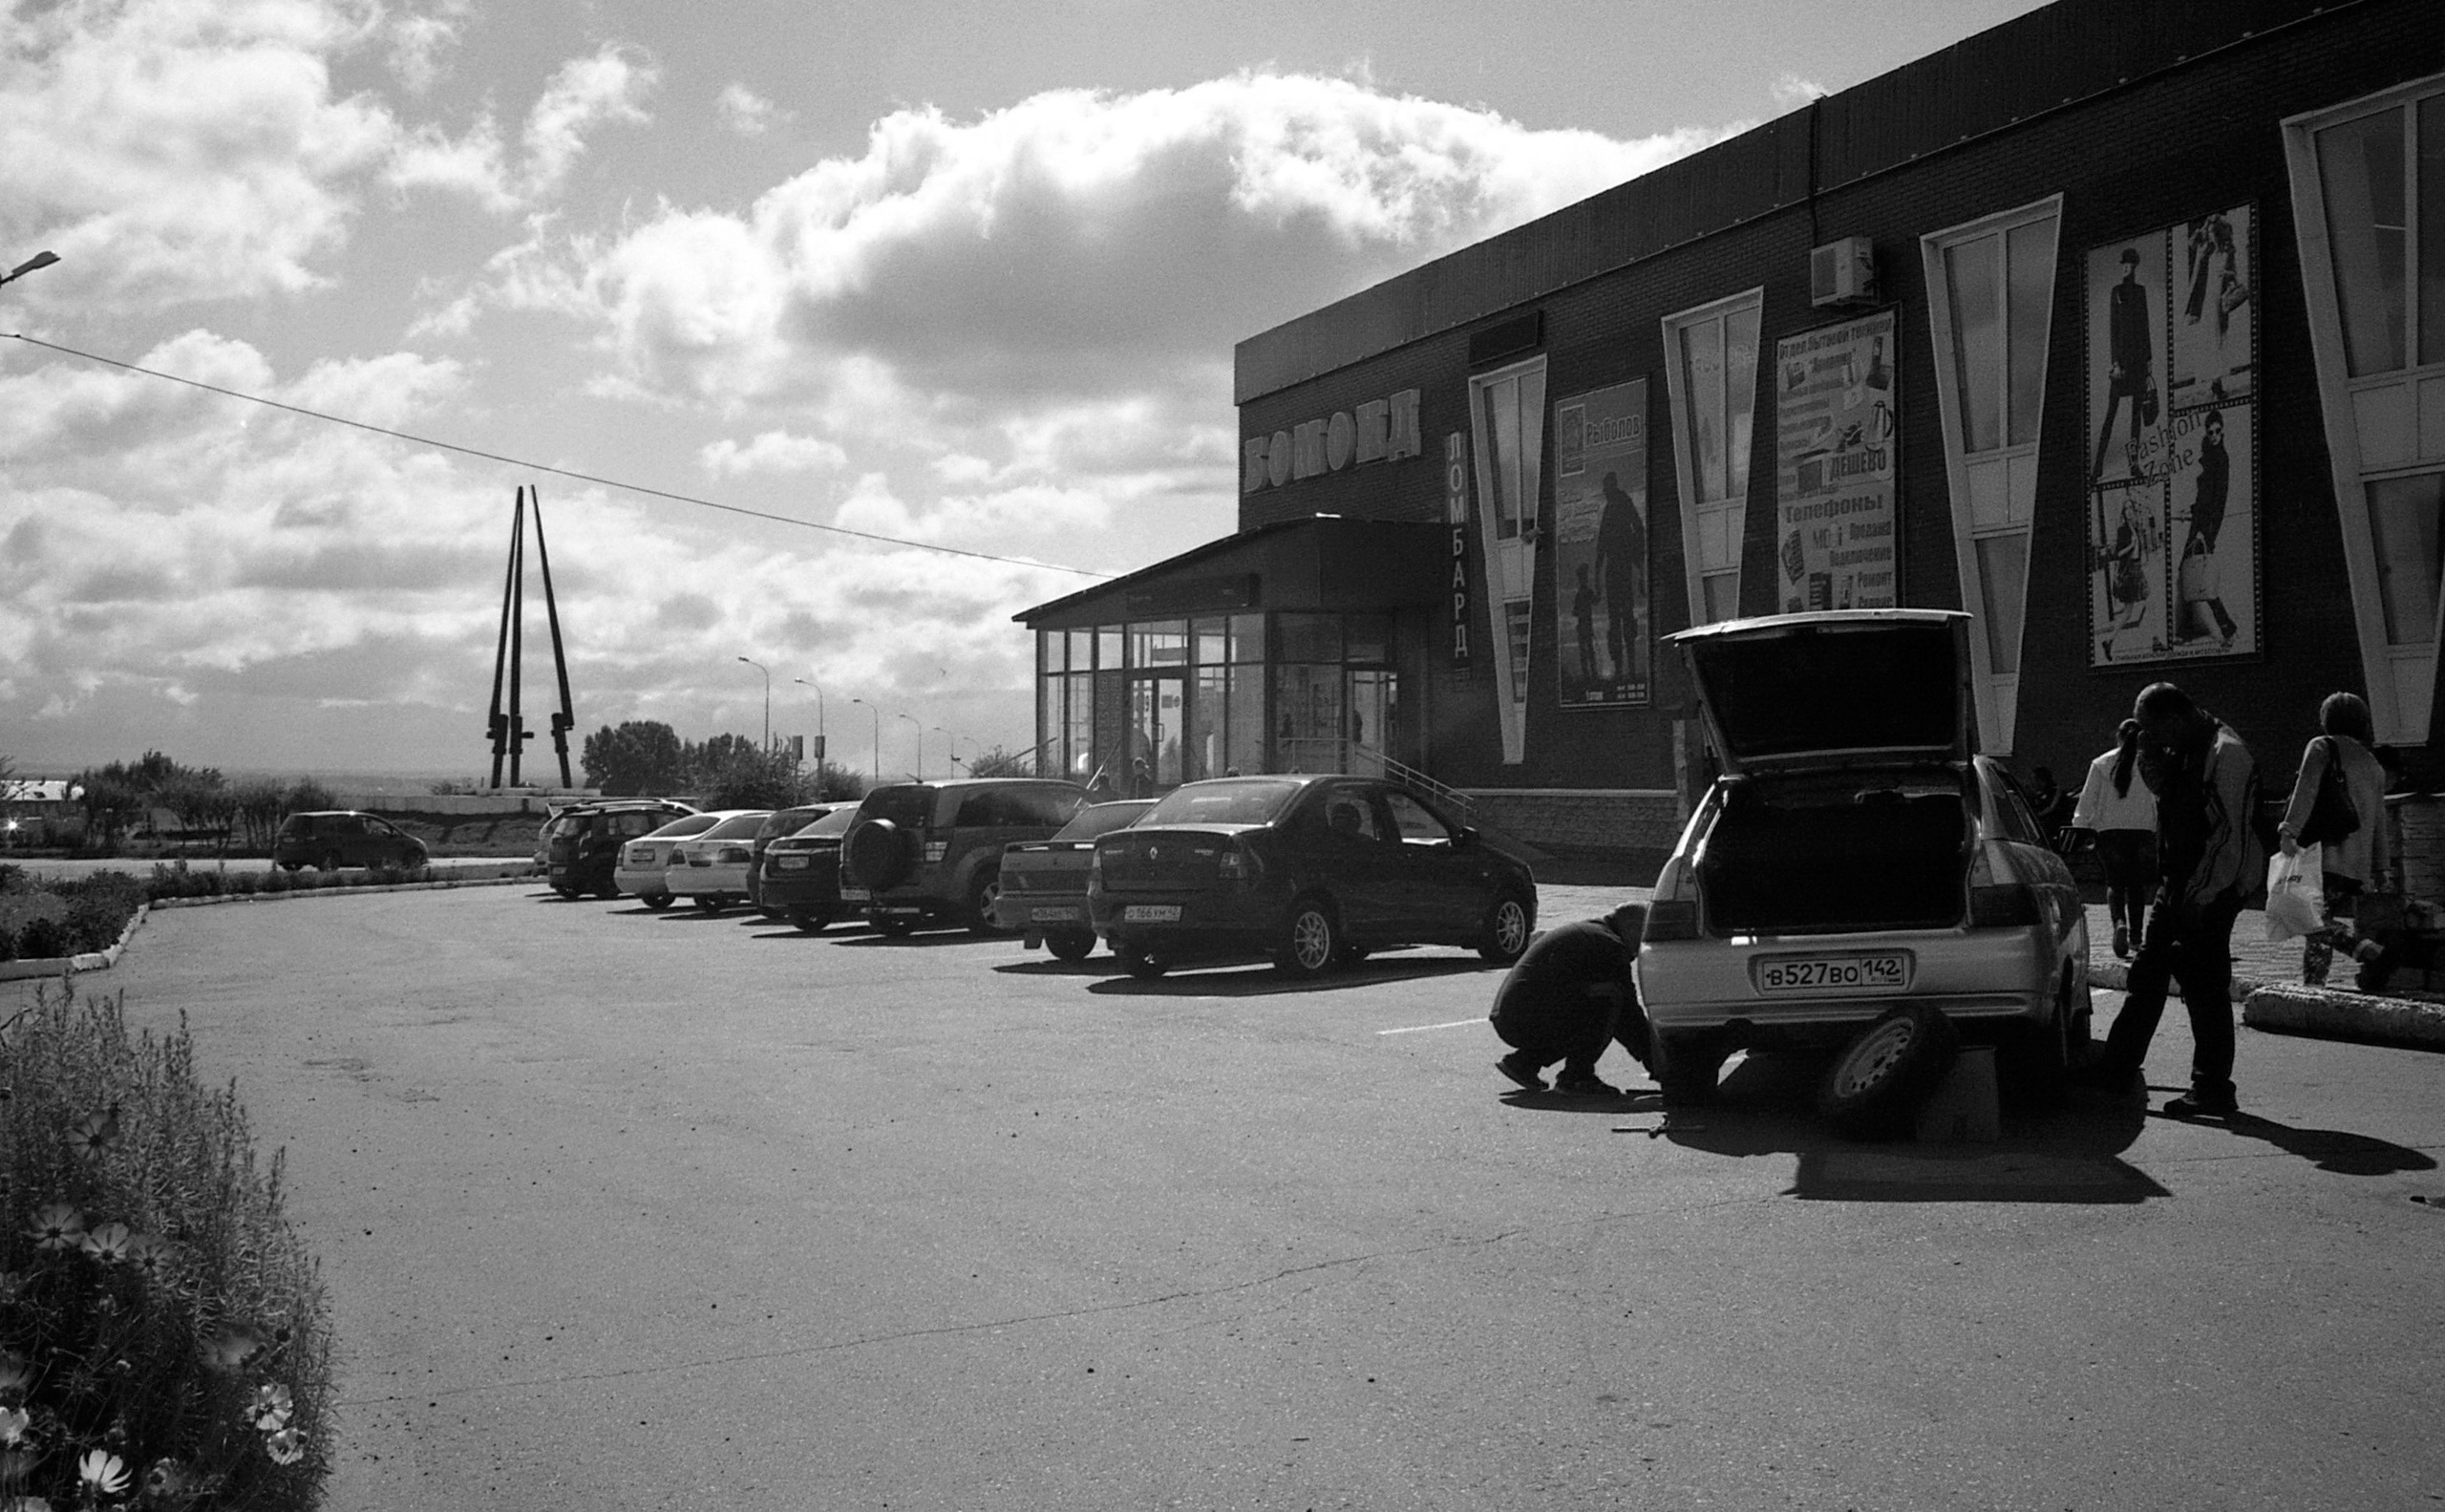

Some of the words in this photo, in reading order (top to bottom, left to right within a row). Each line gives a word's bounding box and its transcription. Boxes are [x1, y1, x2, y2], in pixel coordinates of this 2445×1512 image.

[1586, 415, 1641, 447] Рыболов
[2125, 411, 2200, 468] Fashion
[1830, 449, 1886, 481] ДЕШЕВО
[2144, 449, 2194, 488] Zone
[1785, 494, 1883, 523] Телефоны
[1449, 432, 1469, 659] ЛОМБАРД
[1771, 963, 1859, 986] В527ВО
[1863, 959, 1897, 976] 142
